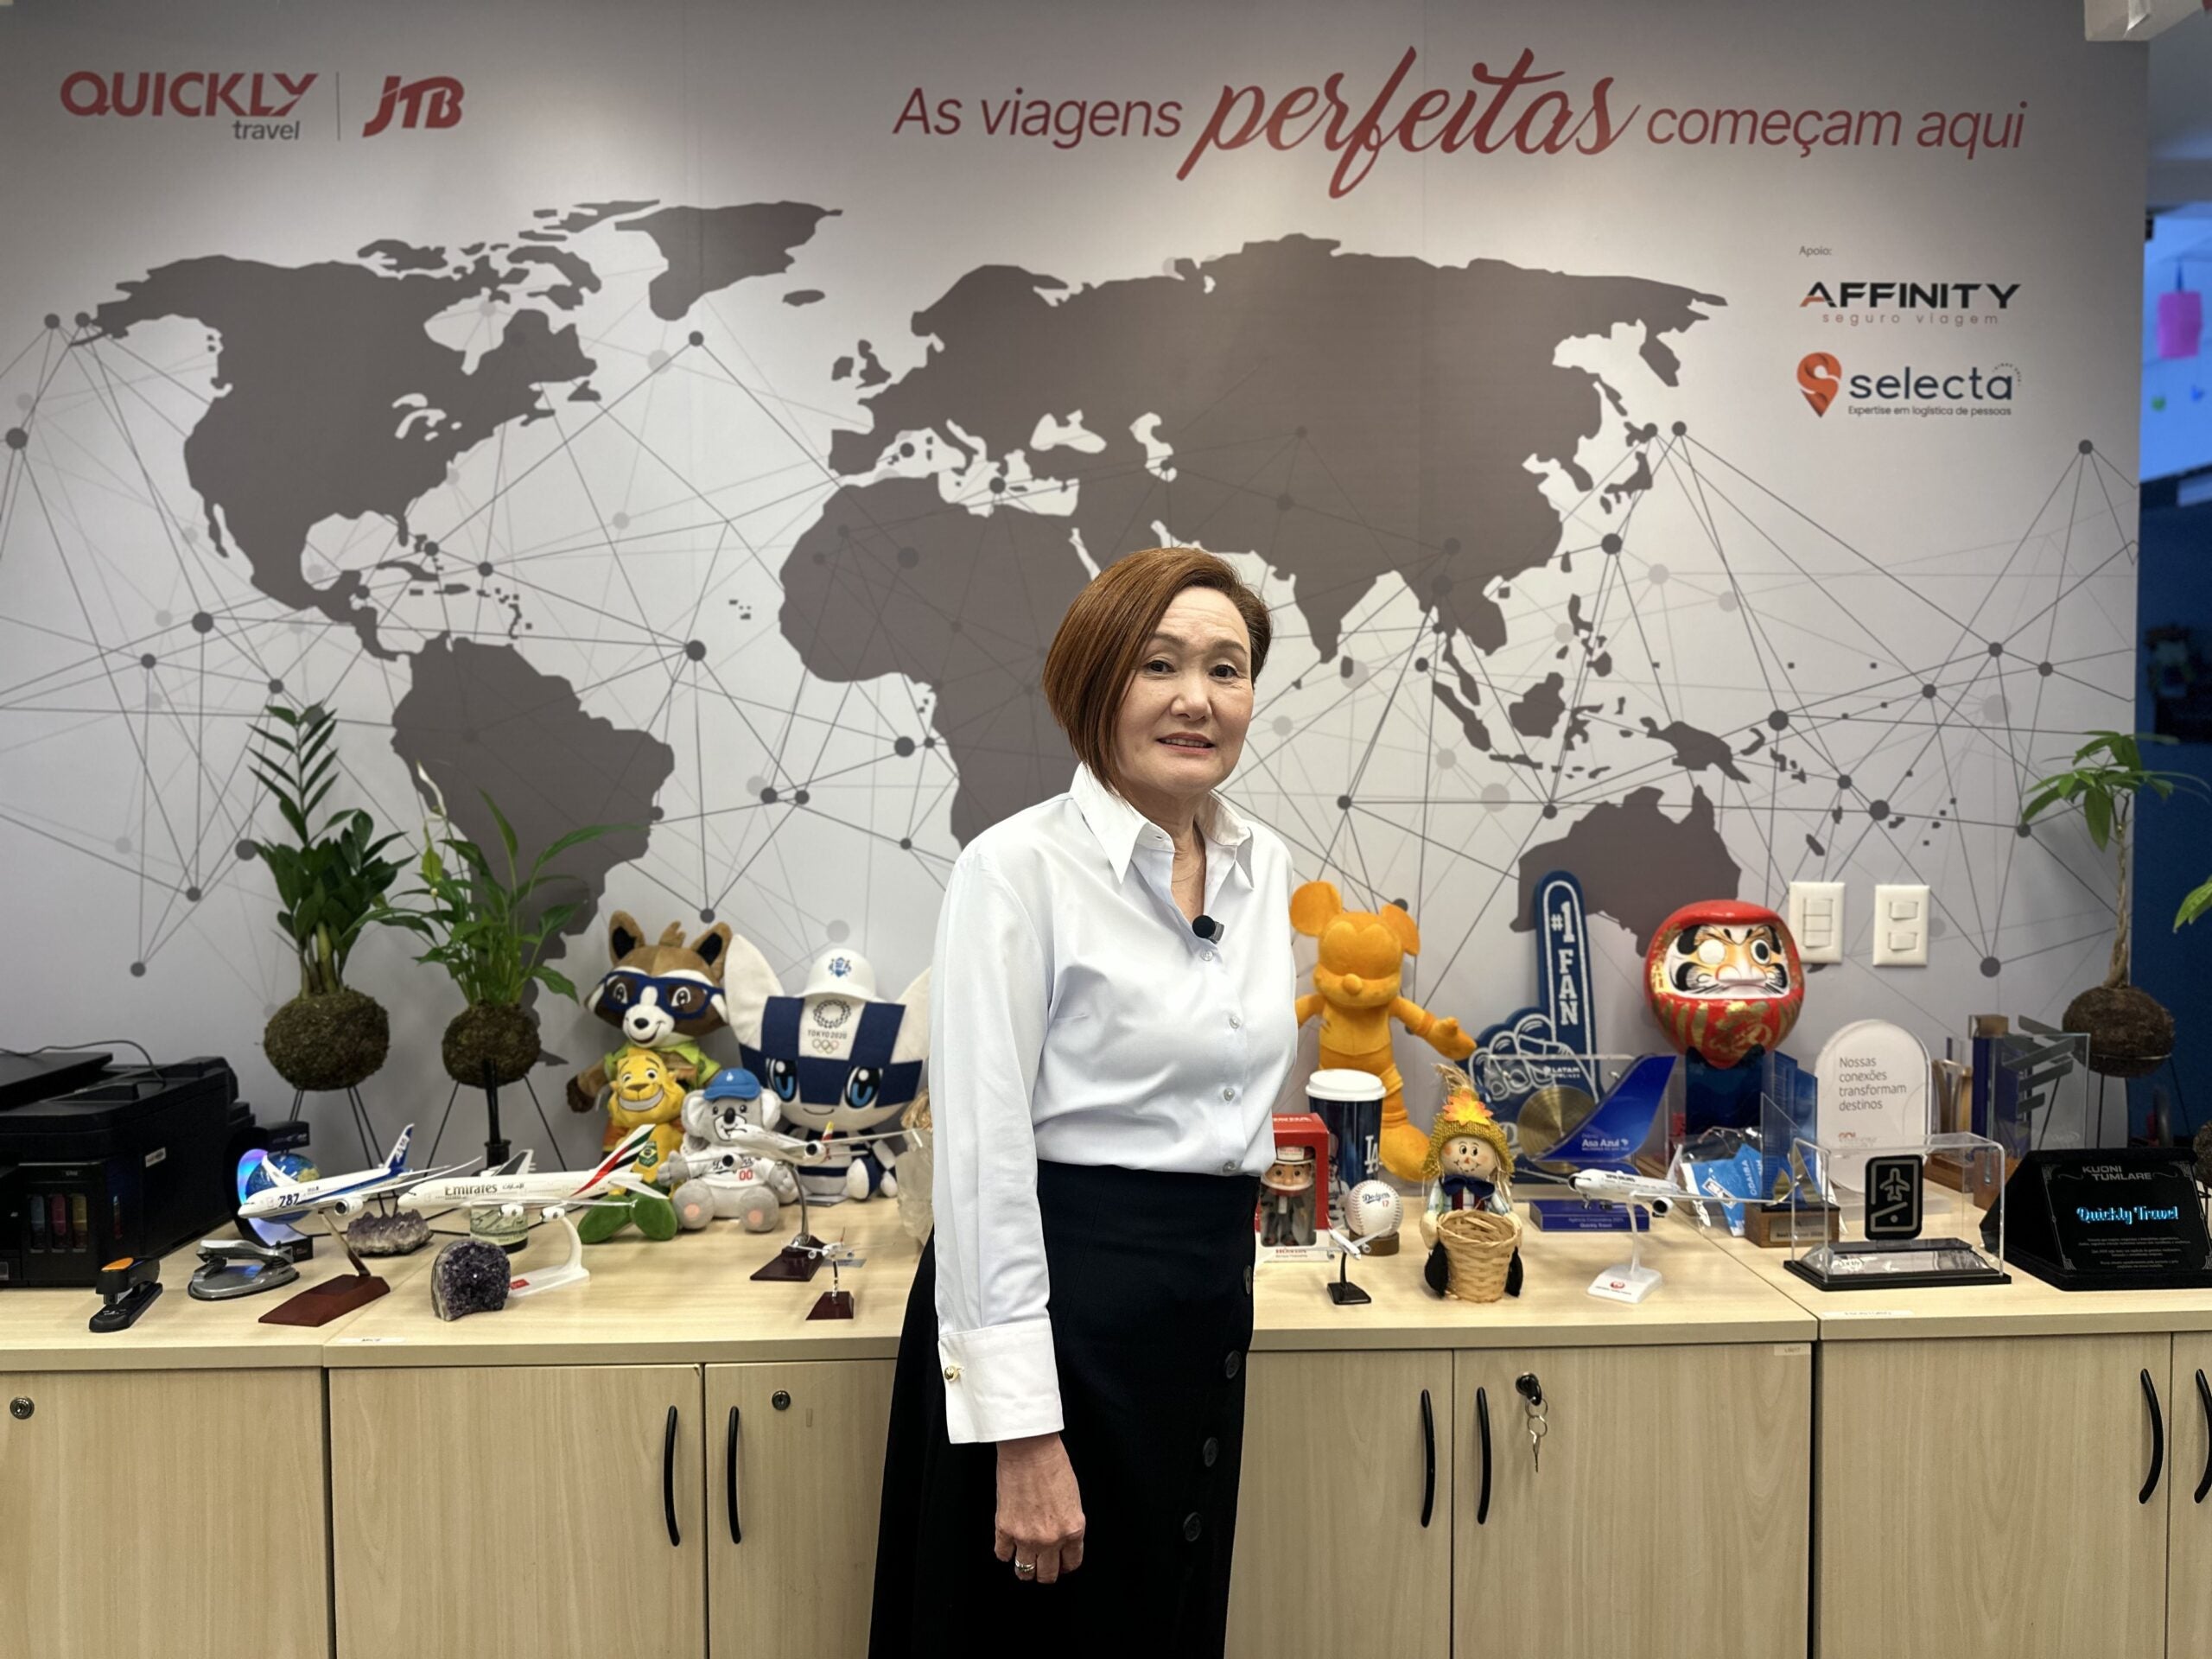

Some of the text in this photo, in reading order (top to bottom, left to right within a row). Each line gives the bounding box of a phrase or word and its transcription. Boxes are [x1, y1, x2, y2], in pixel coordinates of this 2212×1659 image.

[60, 71, 319, 118] QUICKLY
[362, 75, 465, 137] JTB
[893, 46, 2029, 199] As viagens perfeitas começam aqui
[232, 120, 300, 141] travel
[1799, 245, 1833, 257] Apoio:
[1799, 281, 2022, 309] AFFINITY
[1822, 312, 1998, 327] seguro viagem
[1849, 366, 2012, 400] selecta
[1848, 405, 1891, 416] Expertise
[1912, 405, 1954, 417] logística
[1955, 405, 1967, 416] de
[1970, 408, 2012, 417] pessoas
[1551, 900, 1576, 944] #1
[1558, 949, 1579, 1026] FAN
[807, 1029, 848, 1039] TOKYO 2020
[1839, 1057, 1877, 1068] Nossas
[1839, 1070, 1887, 1083] conexões
[1839, 1084, 1907, 1097] transformam
[1839, 1099, 1883, 1112] destinos
[1600, 1138, 1619, 1147] Azul
[740, 1168, 753, 1181] 00
[2082, 1165, 2123, 1173] KUONI
[2091, 1172, 2153, 1181] TUMLARE
[444, 1184, 498, 1196] Emirates
[278, 1192, 300, 1208] 787
[2076, 1205, 2179, 1225] Quickly Travel
